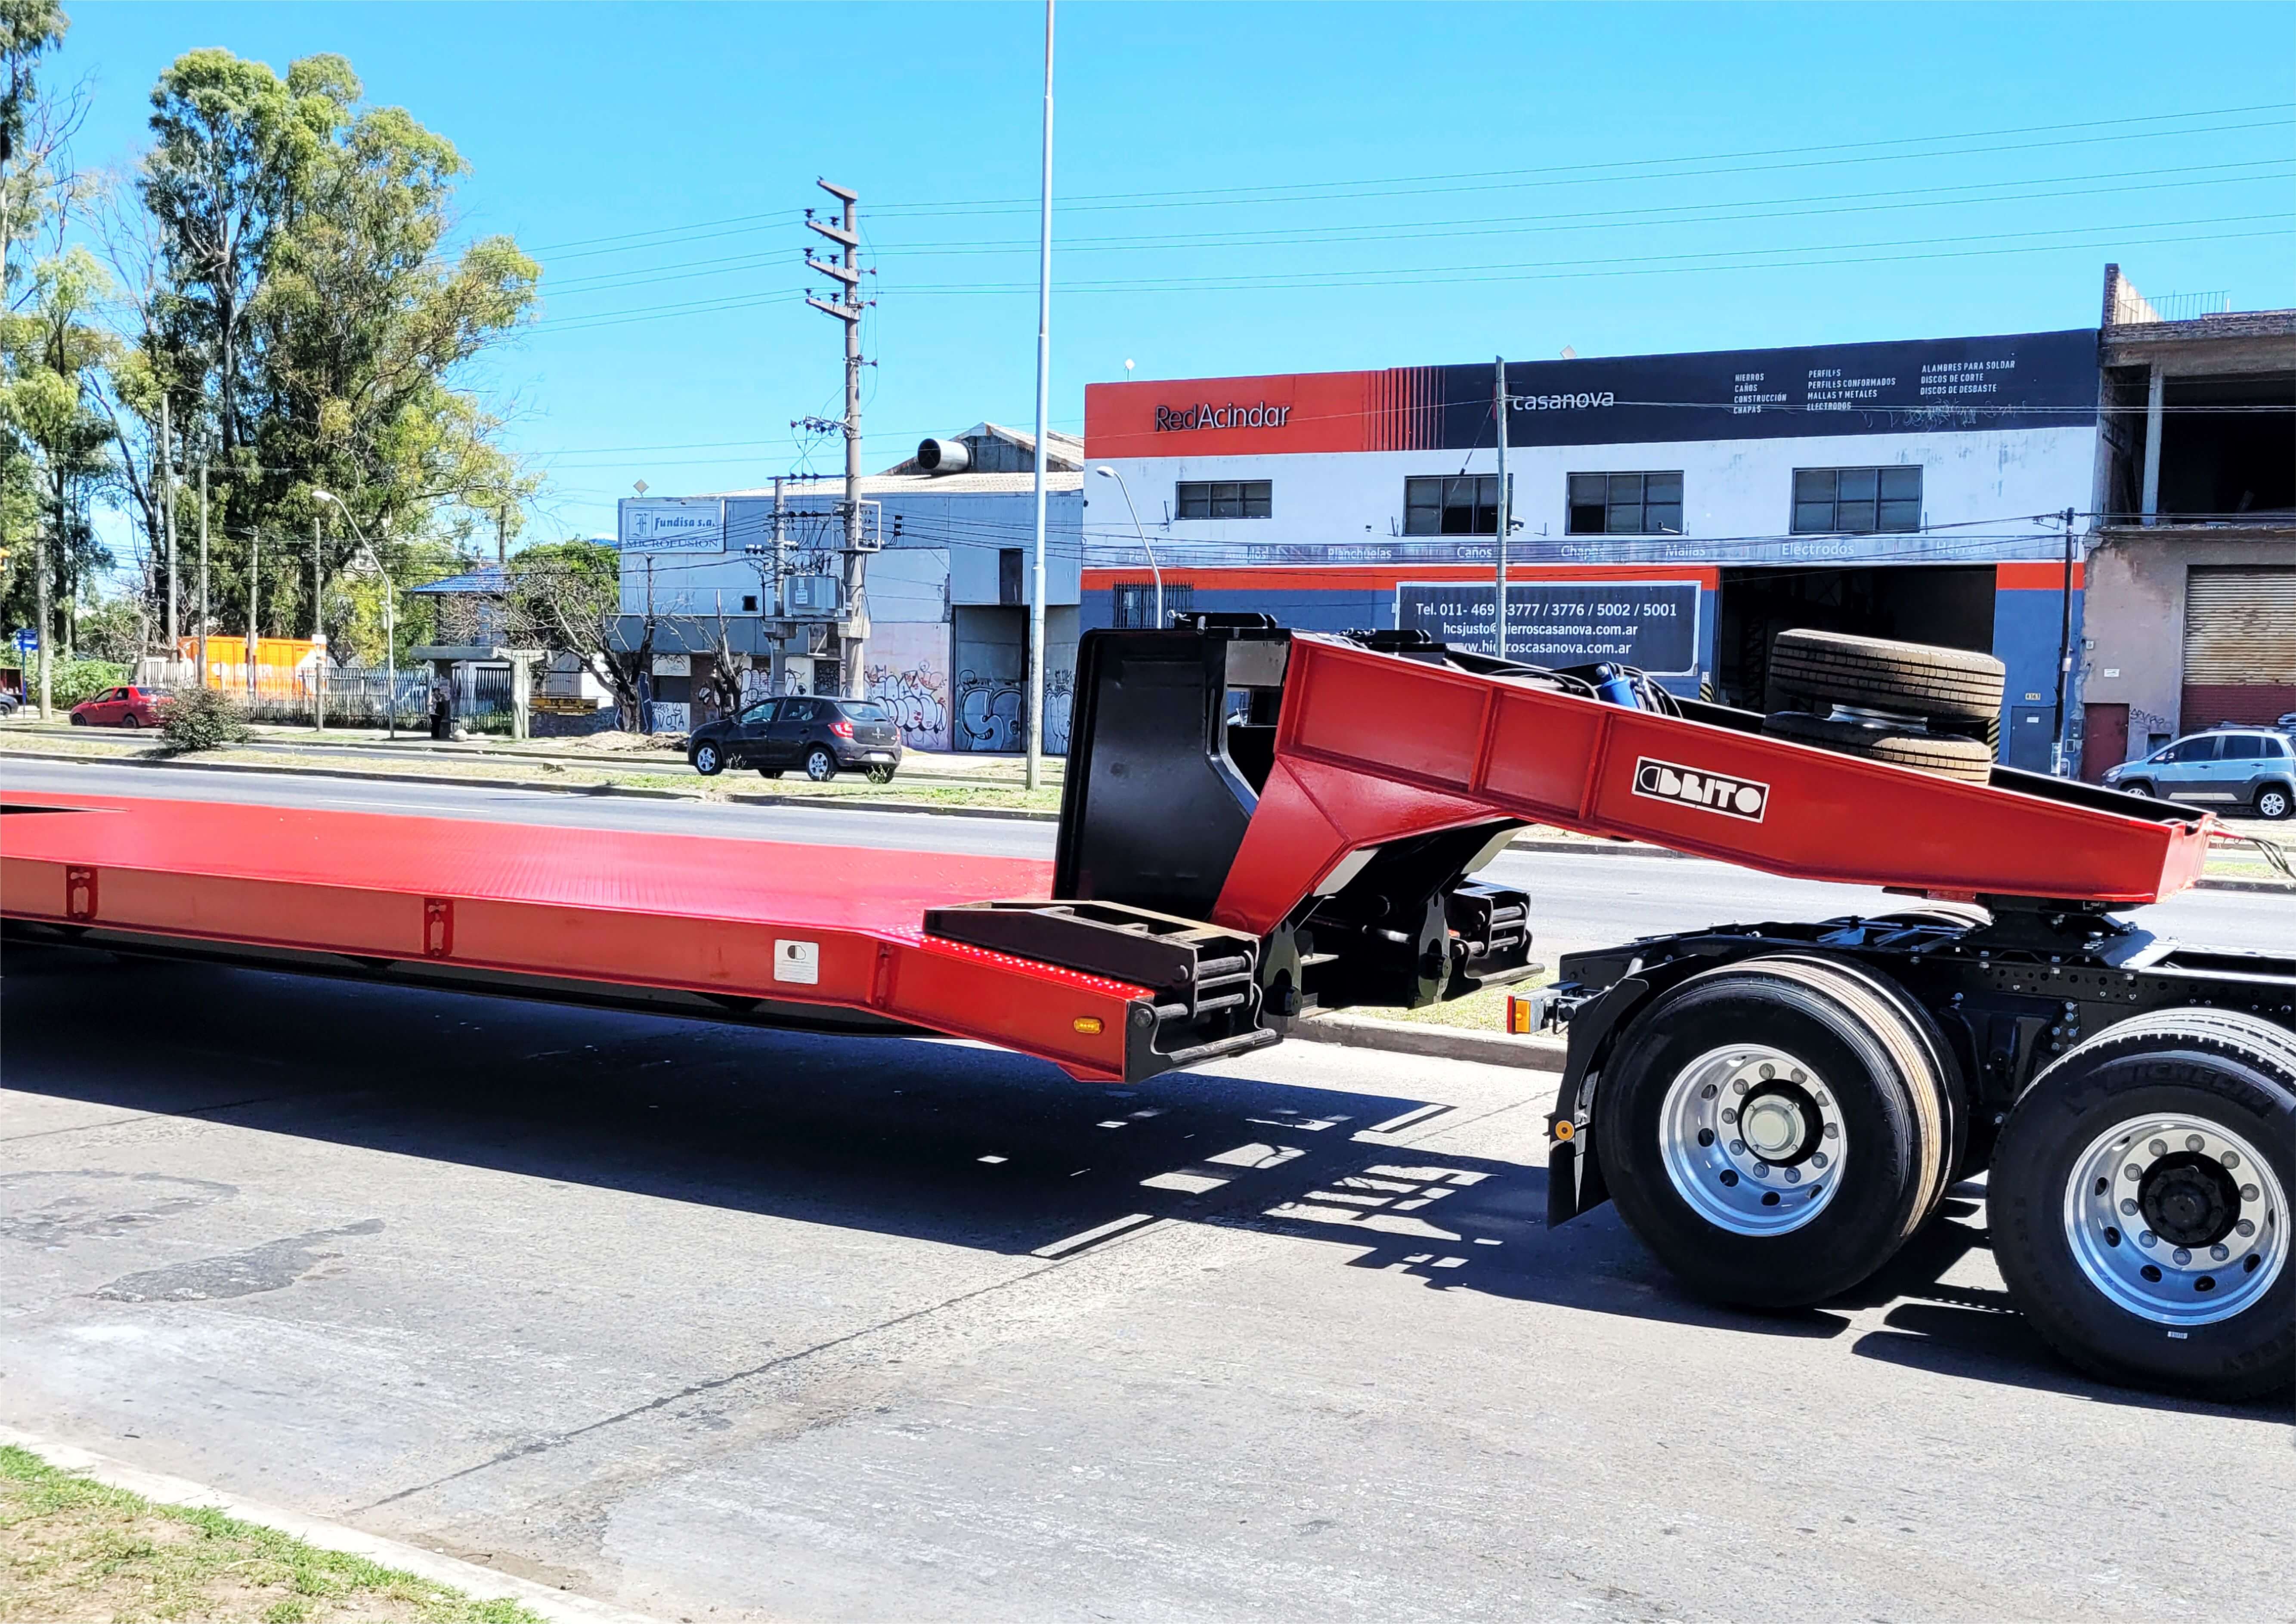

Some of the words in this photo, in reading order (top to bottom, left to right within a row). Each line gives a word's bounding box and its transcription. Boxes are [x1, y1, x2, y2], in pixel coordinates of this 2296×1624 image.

[1922, 362, 1962, 373] ALAMBRES
[1964, 362, 1983, 371] PARA
[1986, 360, 2015, 369] SOLDAR
[1735, 373, 1764, 382] HIERROS
[1809, 368, 1841, 378] PERFILES
[1921, 375, 1947, 384] DISCOS
[1950, 374, 1958, 383] DE
[1960, 373, 1983, 382] CORTE
[1735, 383, 1758, 392] CAÑOS
[1808, 380, 1841, 389] PERFILES
[1843, 377, 1896, 387] CONFORMADOS
[1808, 391, 1836, 400] MALLAS
[1845, 389, 1877, 399] METALES
[1920, 386, 1946, 395] DISCOS
[1948, 385, 1958, 394] DE
[1959, 384, 1997, 393] DESBASTE
[1513, 392, 1614, 411] casanova
[1734, 392, 1787, 403] CONSTRUCCIÓN
[1733, 405, 1761, 414] CHAPAS
[1807, 402, 1851, 411] ELECTRODOS
[1155, 401, 1290, 431] RedAcindar
[1328, 546, 1392, 560] Planchuelas
[1457, 546, 1492, 559] Caños
[1782, 543, 1854, 556] Electrodos
[1416, 603, 1436, 616] Tel.
[1440, 603, 1467, 616] 011-
[1551, 604, 1584, 616] 3776
[1597, 604, 1630, 616] 5002
[1643, 604, 1677, 616] 5001
[1443, 622, 1638, 637] hcsjusto@ierroscasanova.com.ar
[658, 714, 684, 728] VOTA
